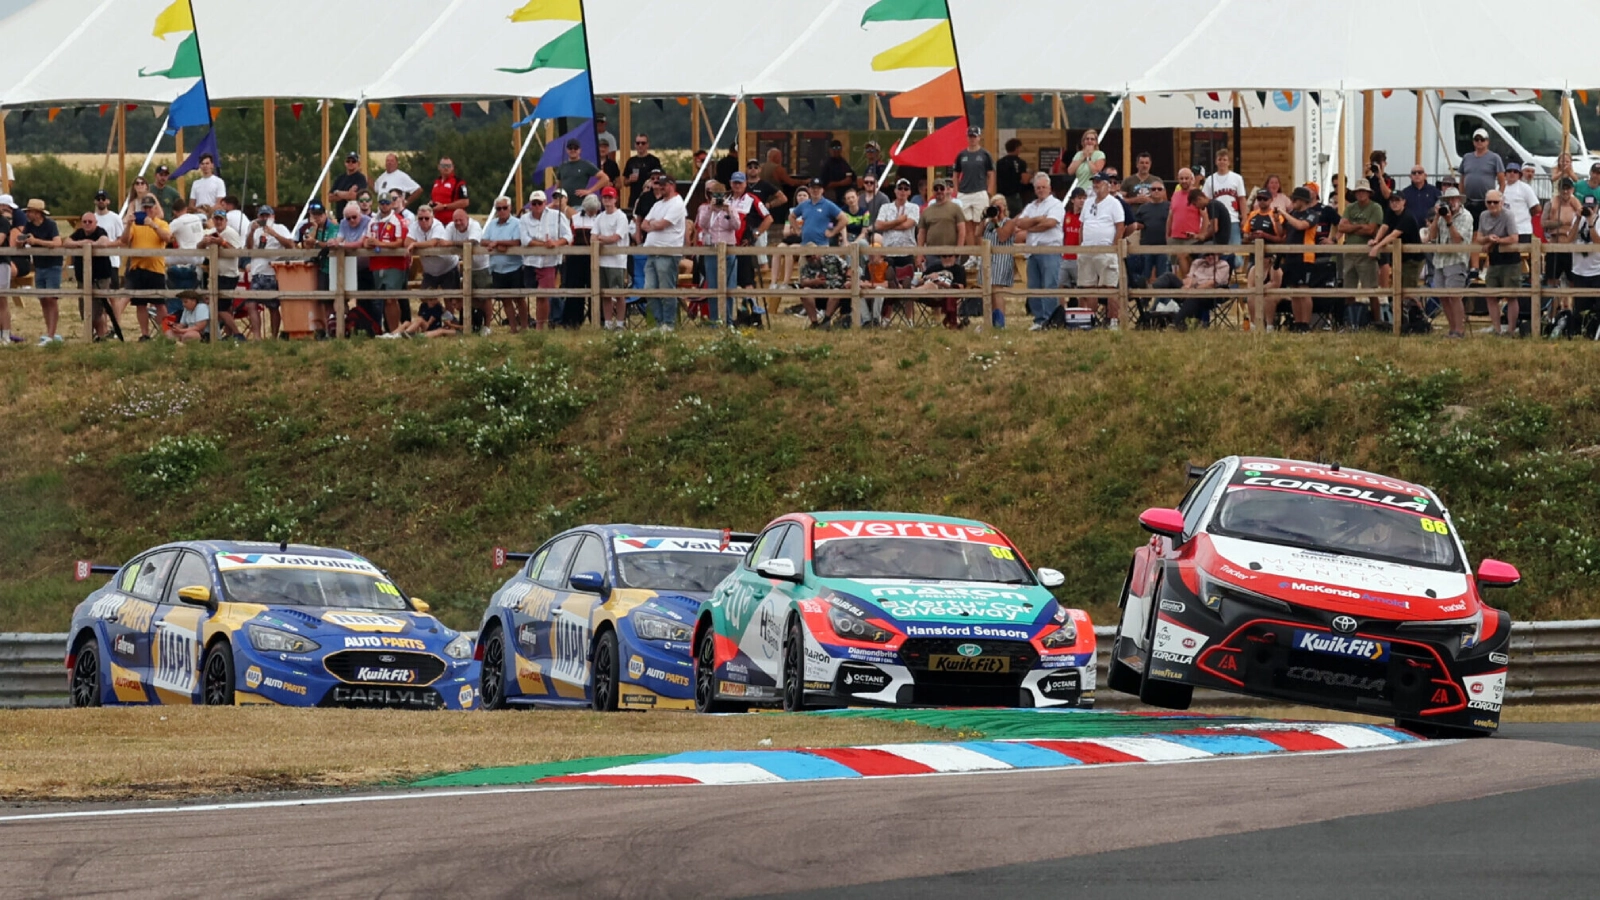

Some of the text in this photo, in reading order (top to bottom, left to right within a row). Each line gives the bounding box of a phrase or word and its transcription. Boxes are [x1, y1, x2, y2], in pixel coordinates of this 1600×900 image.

[1195, 106, 1233, 120] Team
[1290, 465, 1426, 497] morson
[1243, 477, 1427, 513] COROLLA
[1420, 518, 1449, 535] 66
[989, 546, 1014, 560] 80
[270, 556, 374, 571] Valvoline
[1292, 582, 1361, 599] McKenzie
[906, 625, 1029, 639] Hansford Sensors
[344, 636, 426, 650] AUTO PARTS
[158, 624, 193, 689] NAPA
[848, 647, 898, 659] Diamondbrite
[1152, 650, 1193, 665] COROLLA
[665, 674, 690, 687] PARTS
[853, 674, 885, 683] OCTANE
[333, 687, 437, 706] CARLYLE
